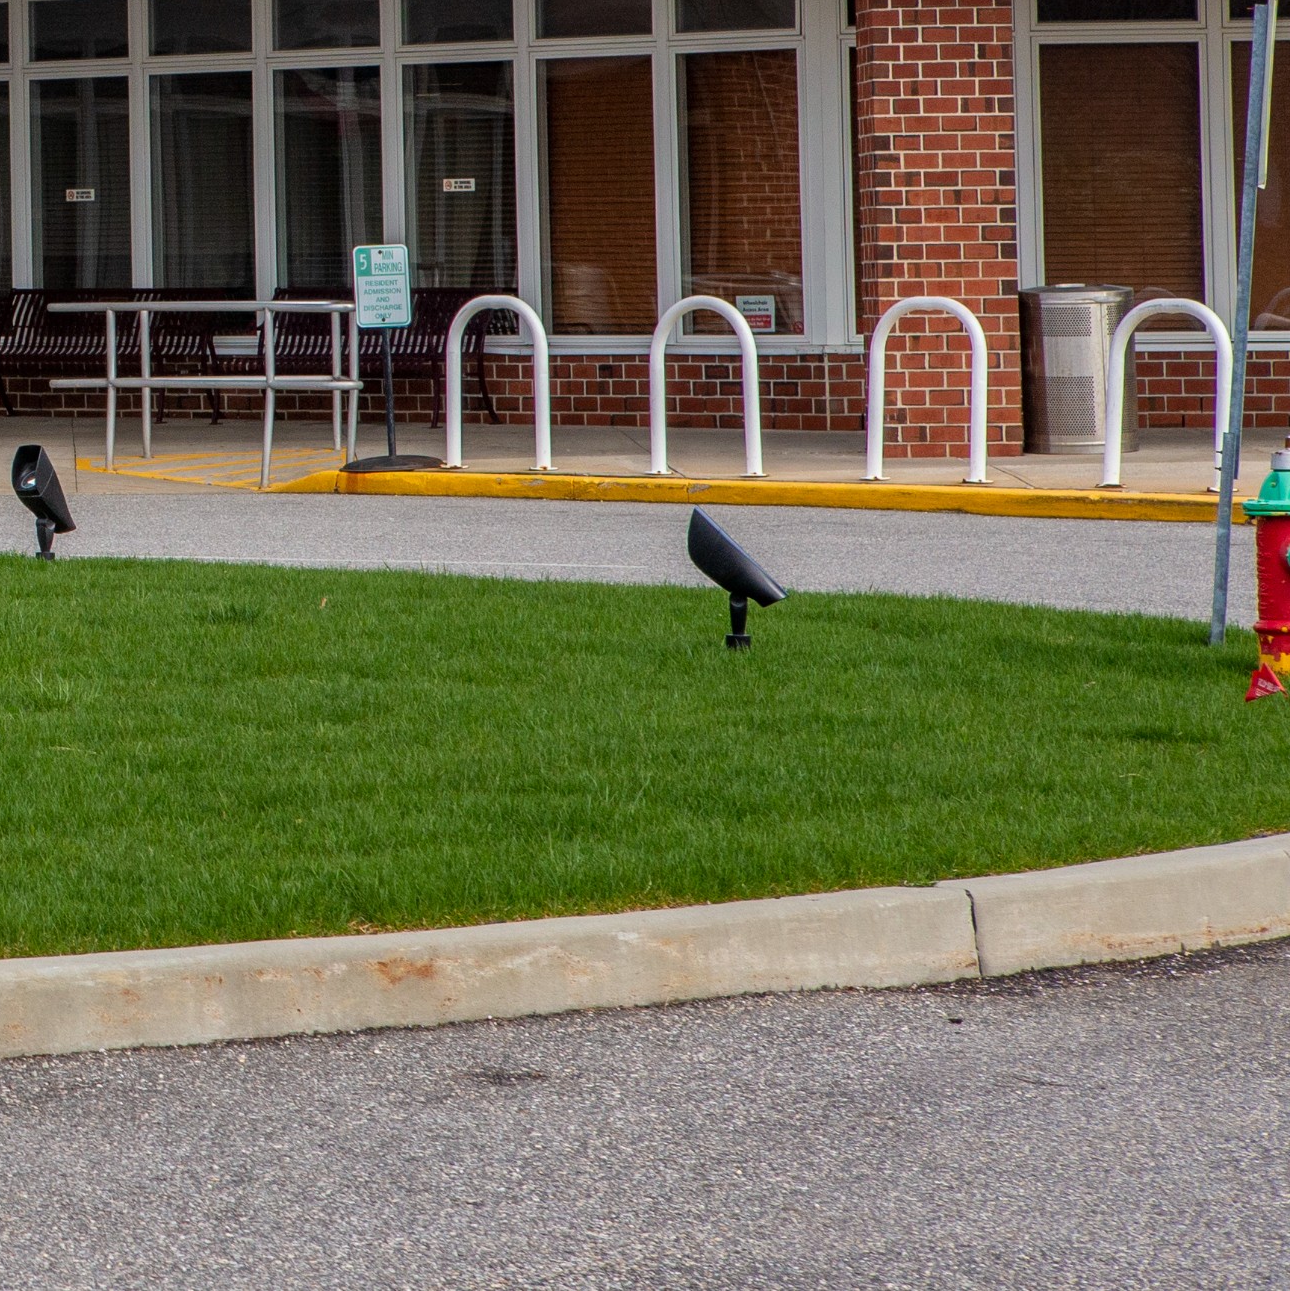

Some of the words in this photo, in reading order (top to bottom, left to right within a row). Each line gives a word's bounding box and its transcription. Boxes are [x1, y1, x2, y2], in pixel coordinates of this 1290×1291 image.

[382, 250, 394, 260] MIN
[359, 254, 367, 270] 5
[374, 262, 402, 273] PARKING
[365, 279, 398, 287] RESIDENT
[364, 303, 402, 311] DISCHARGE
